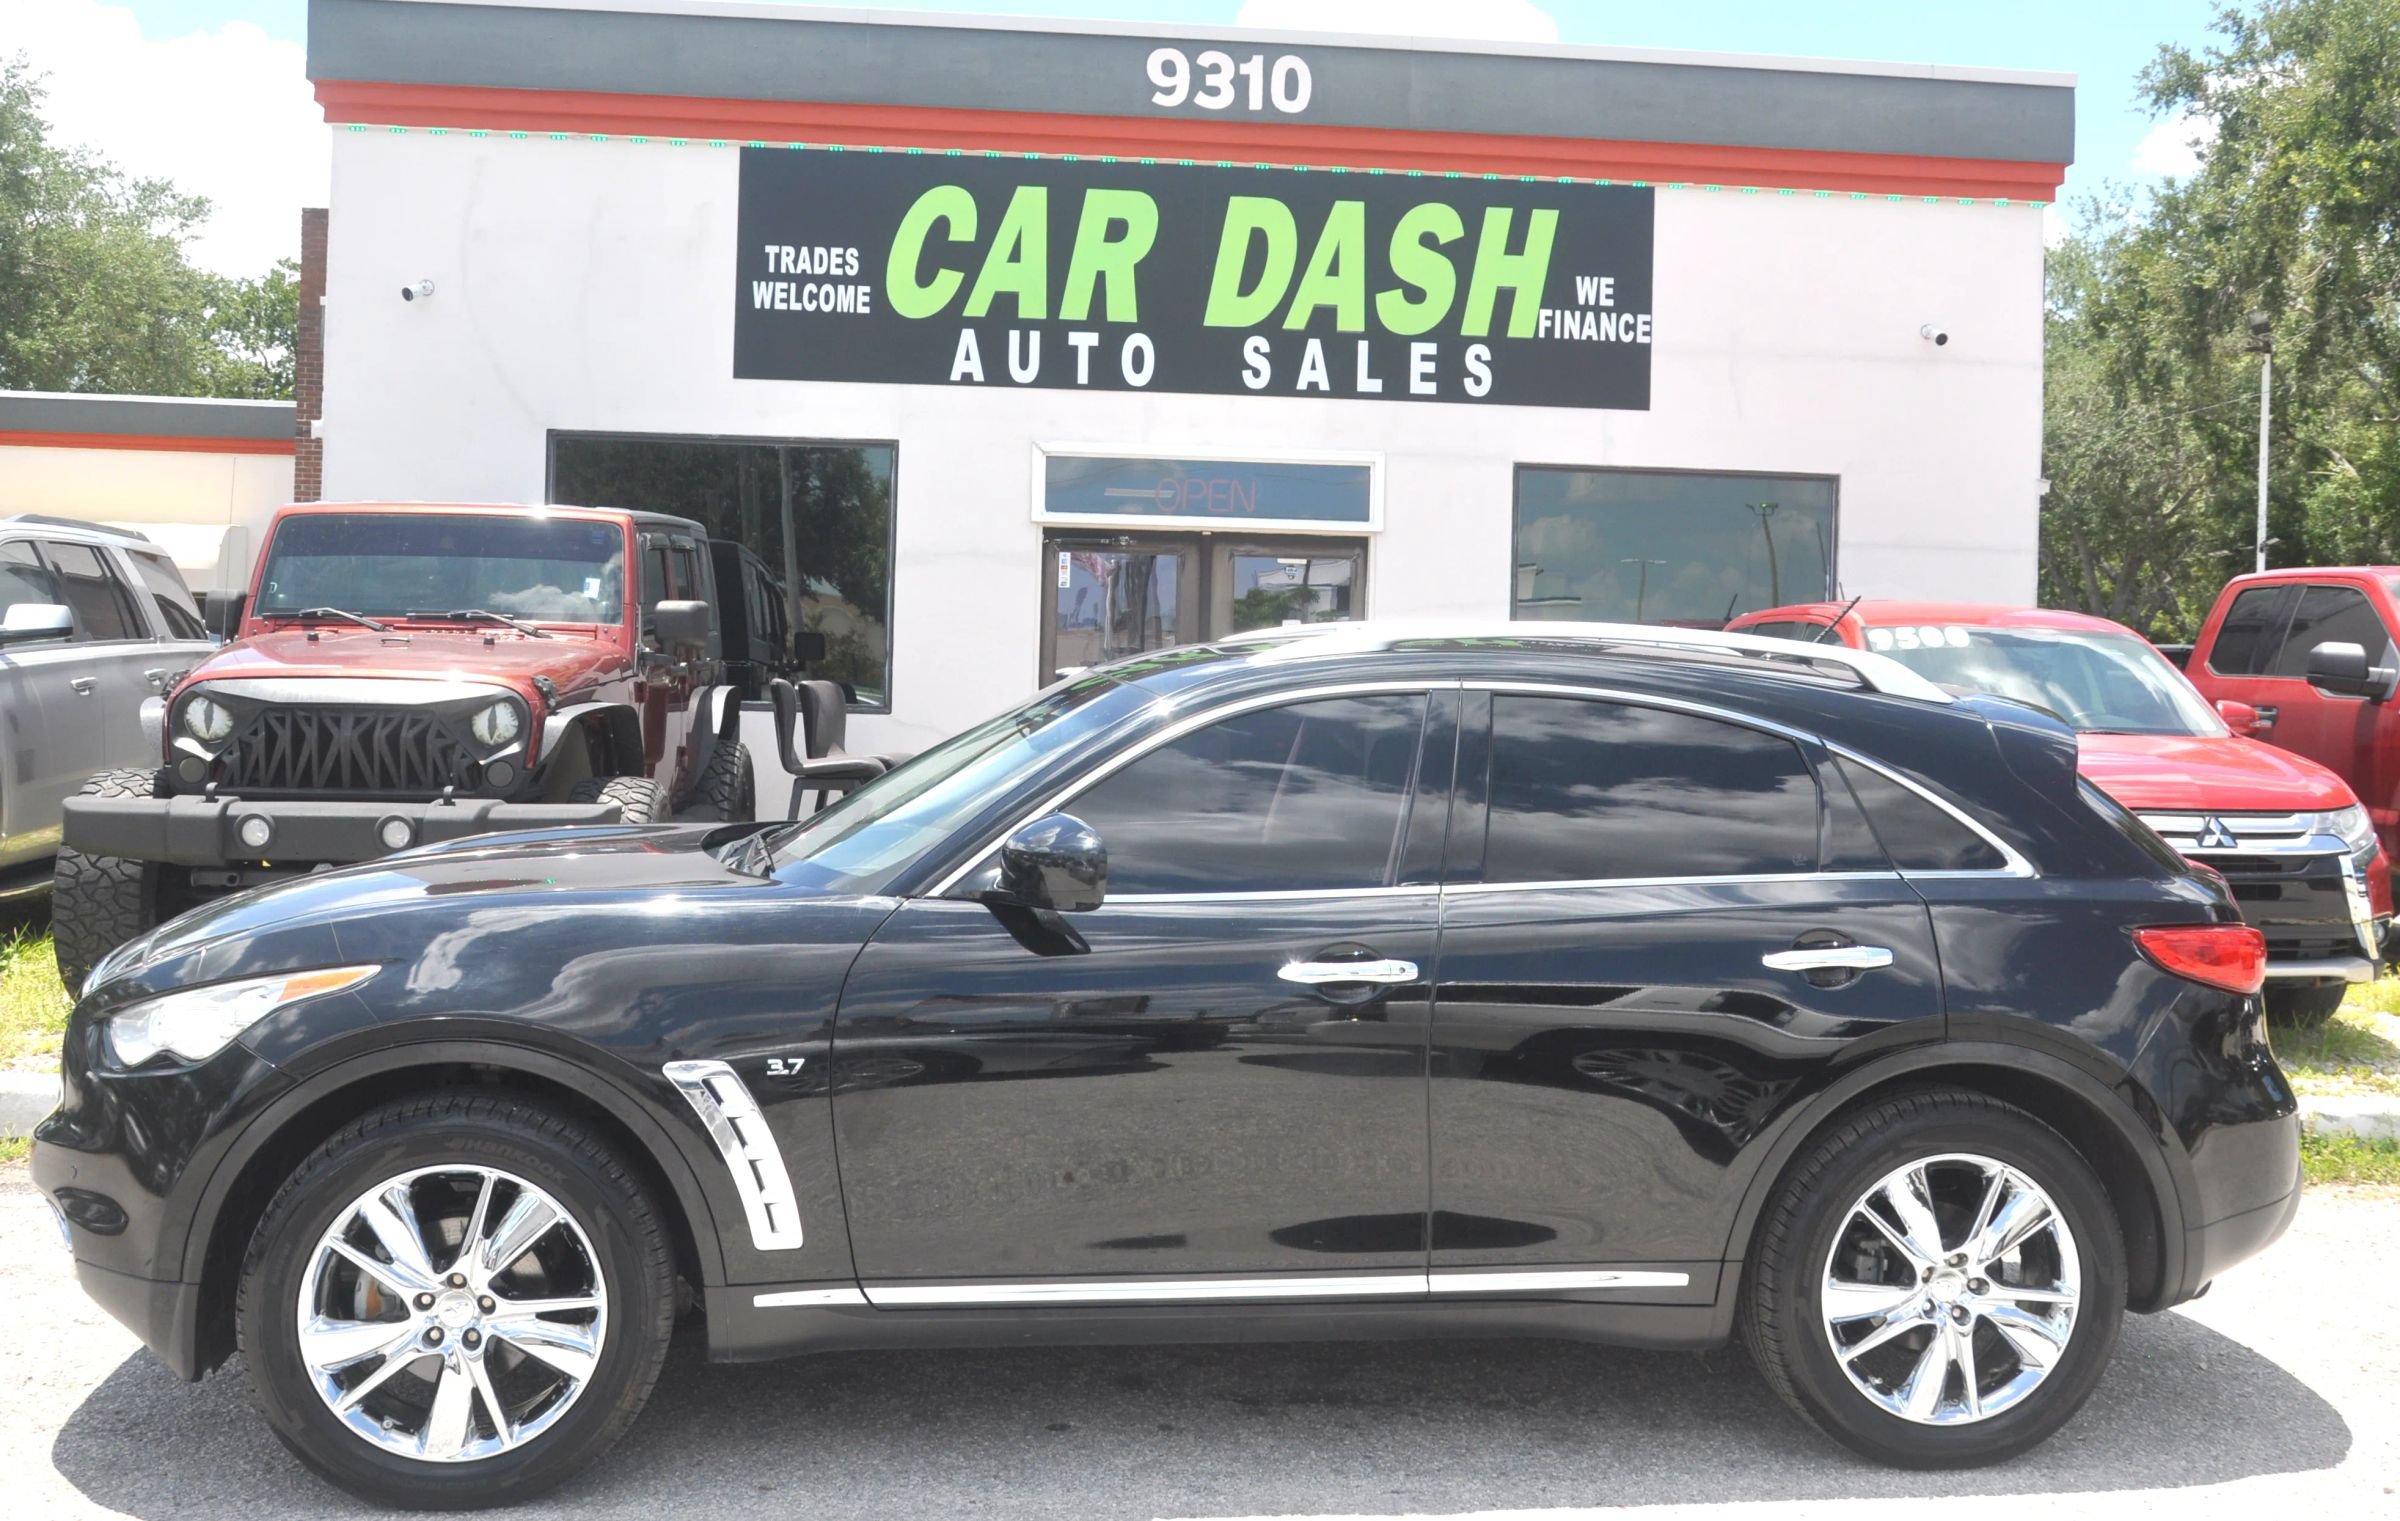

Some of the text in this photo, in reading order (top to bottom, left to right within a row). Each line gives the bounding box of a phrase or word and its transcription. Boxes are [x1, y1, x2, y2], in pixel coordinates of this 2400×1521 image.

[1146, 47, 1312, 114] 9310
[764, 244, 860, 276] TRADES
[886, 185, 1560, 339] CAR DASH
[752, 280, 871, 314] WELCOME
[1575, 275, 1615, 307] WE
[1537, 308, 1651, 345] FINANCE
[948, 327, 1494, 398] AUTO SALES
[1154, 479, 1257, 512] OPEN
